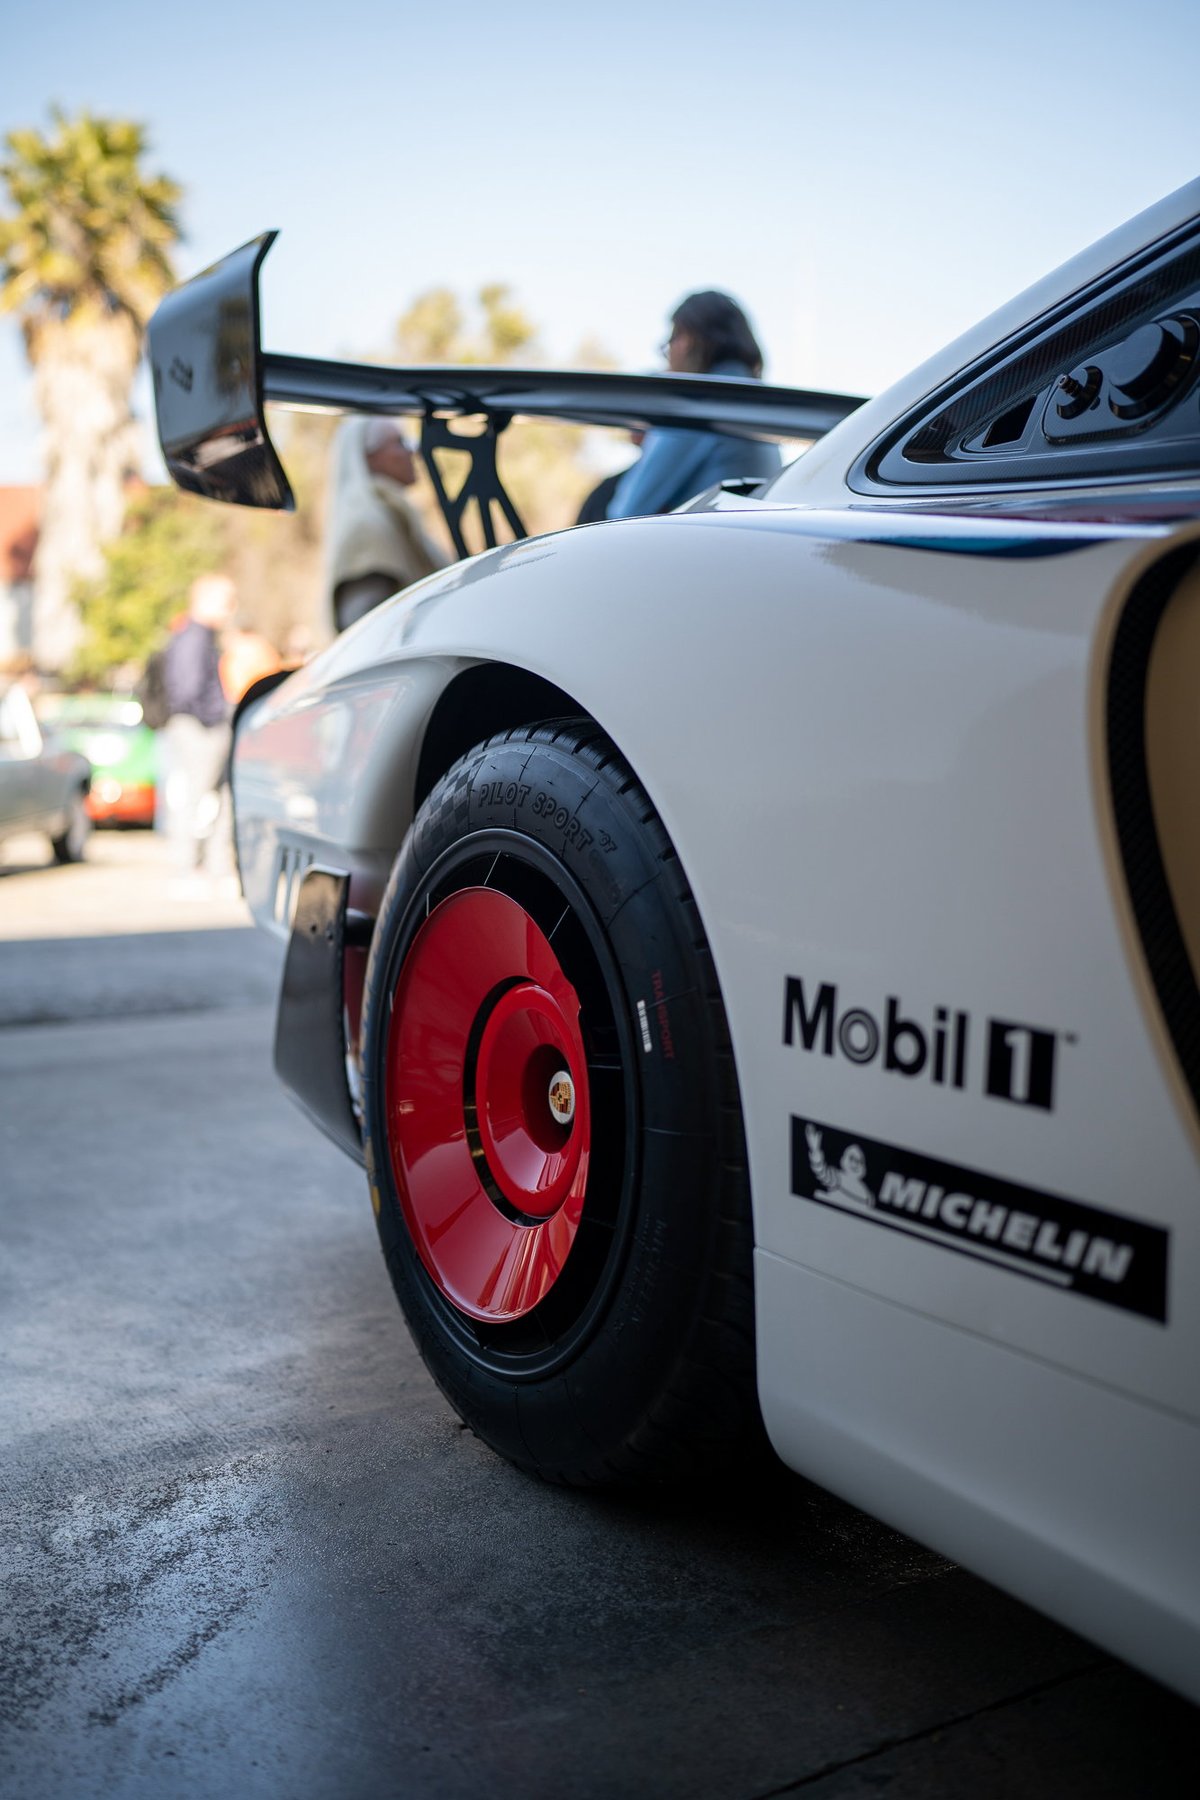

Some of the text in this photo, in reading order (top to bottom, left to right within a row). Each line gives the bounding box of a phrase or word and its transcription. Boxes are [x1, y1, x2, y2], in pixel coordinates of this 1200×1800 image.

[478, 781, 531, 808] PILOT
[532, 792, 593, 852] SPORT
[782, 975, 1034, 1102] Mobil 1
[878, 1171, 1134, 1284] MICHELIN
